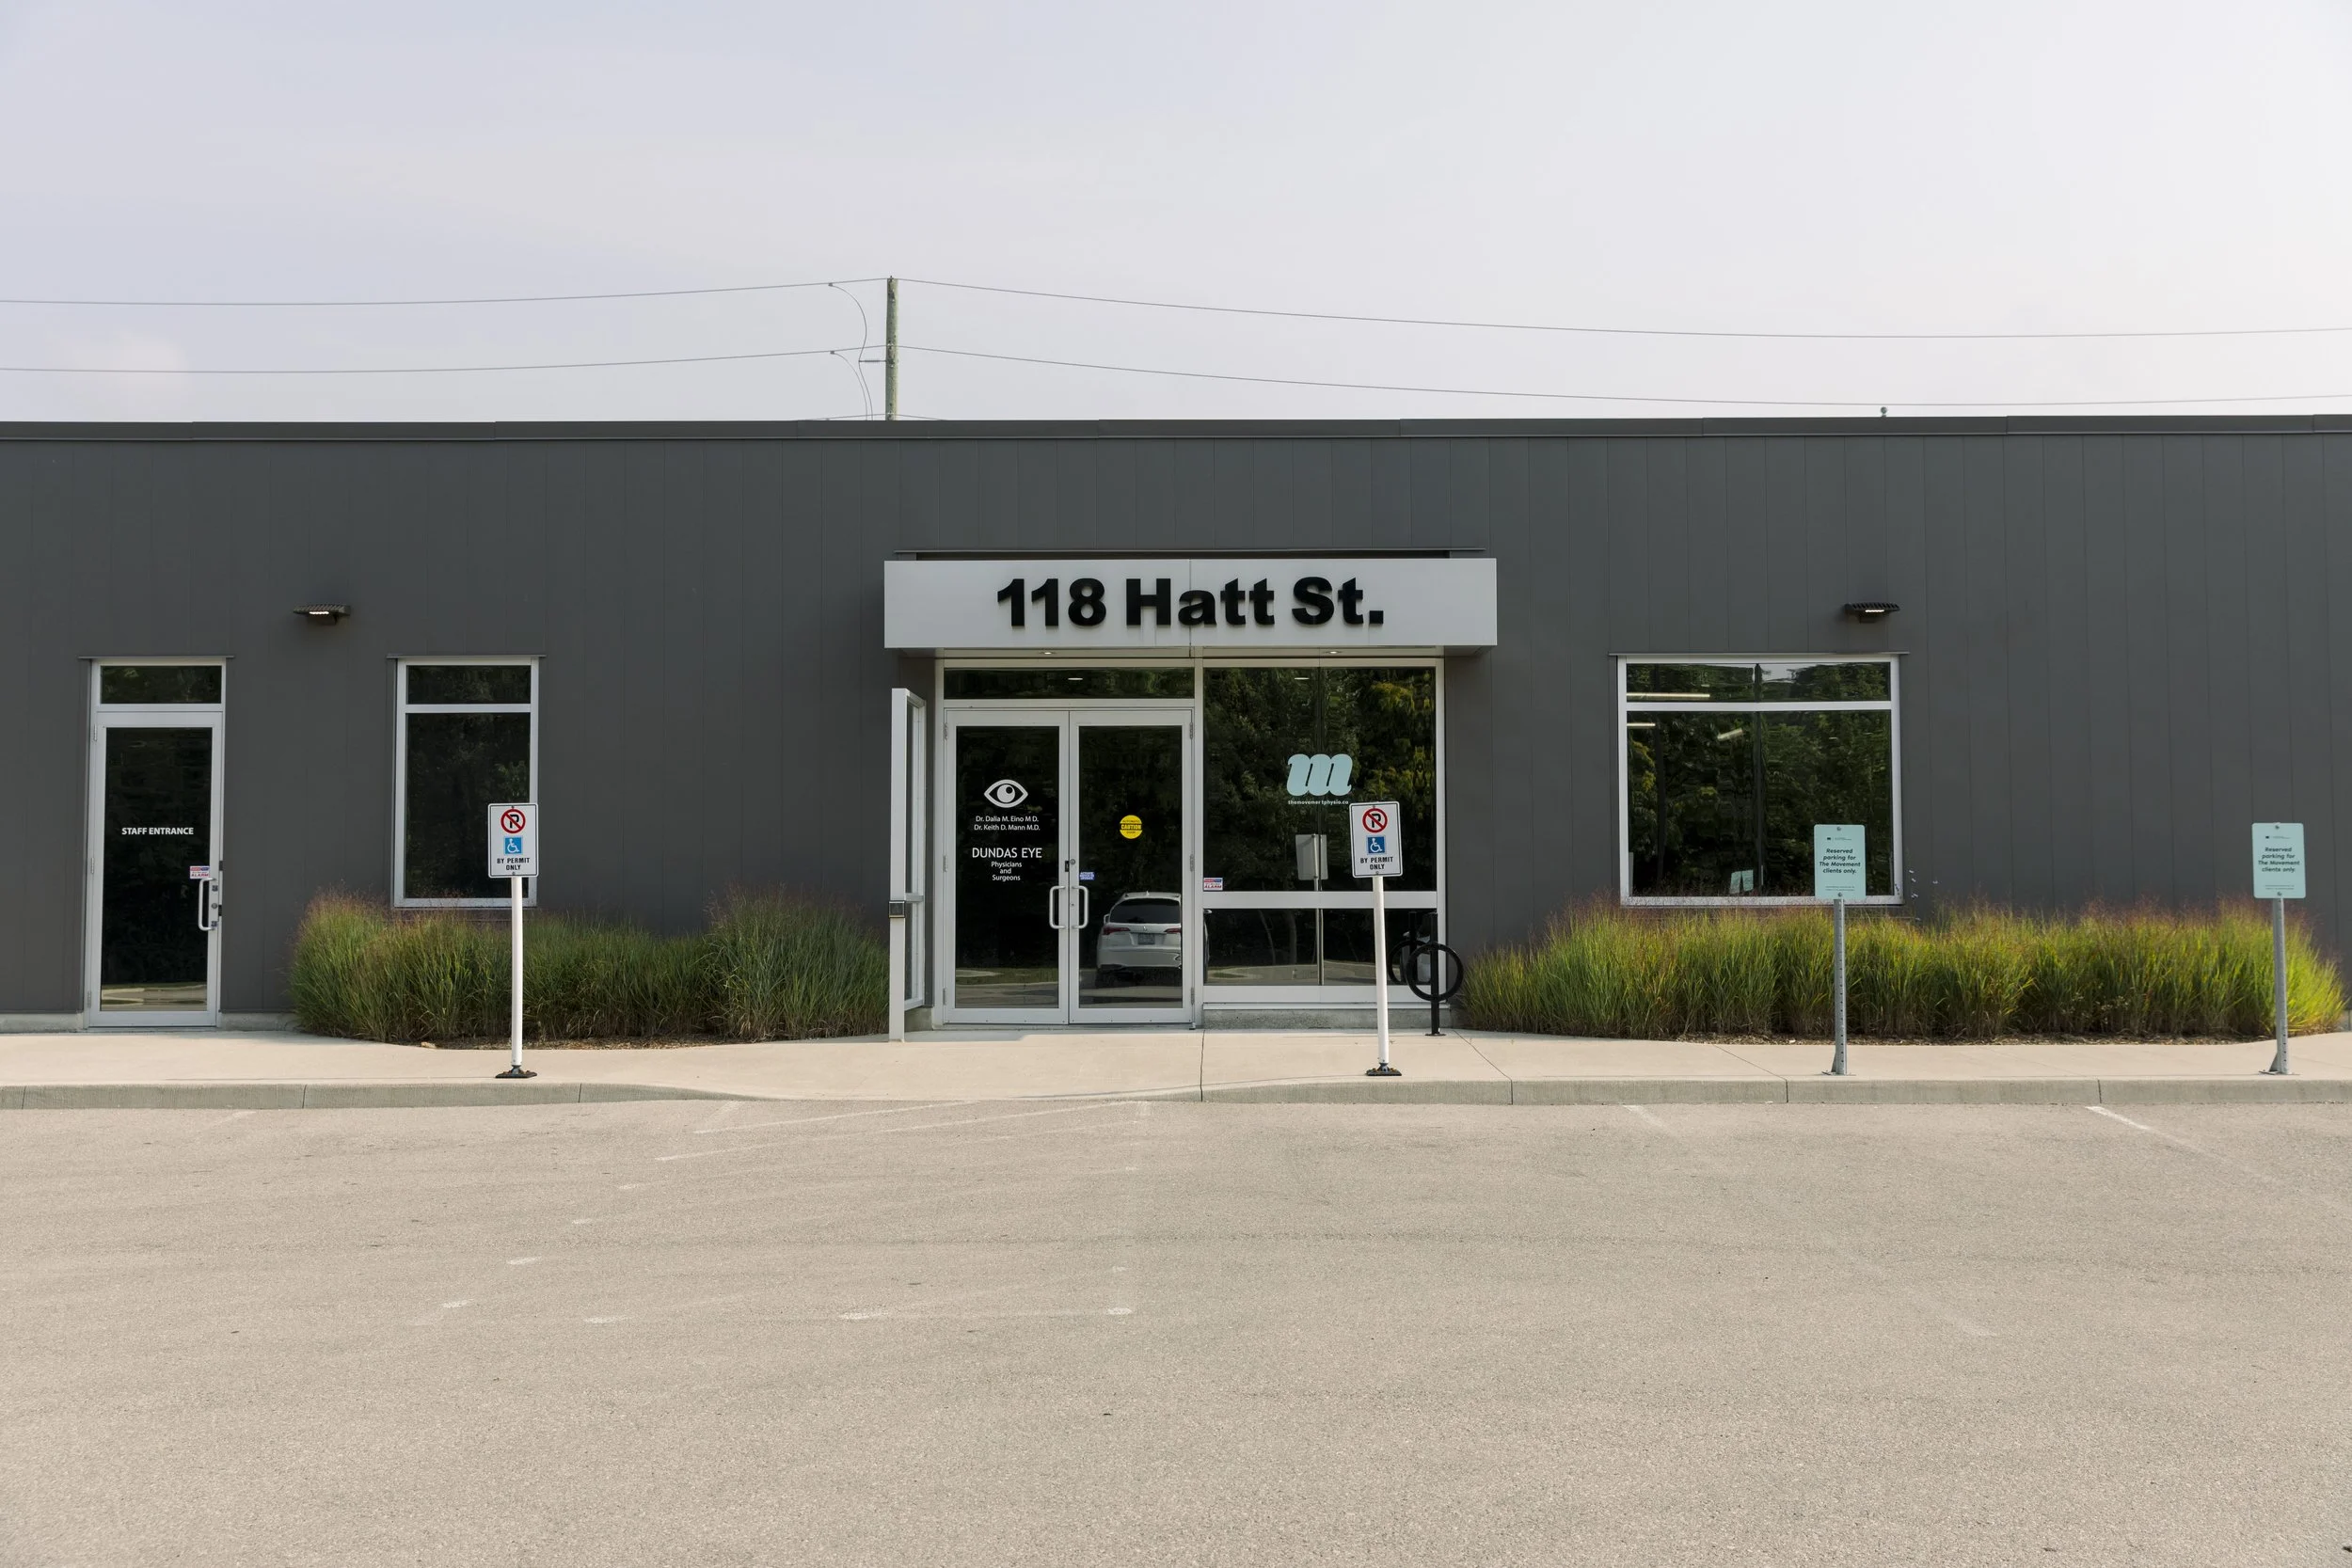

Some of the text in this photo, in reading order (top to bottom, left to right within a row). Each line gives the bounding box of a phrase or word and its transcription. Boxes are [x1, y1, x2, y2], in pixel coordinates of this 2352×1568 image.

[997, 576, 1384, 627] 118 Hatt St.
[121, 827, 194, 835] STAFF ENTRANCE
[972, 847, 1042, 858] DUNDAS EYE
